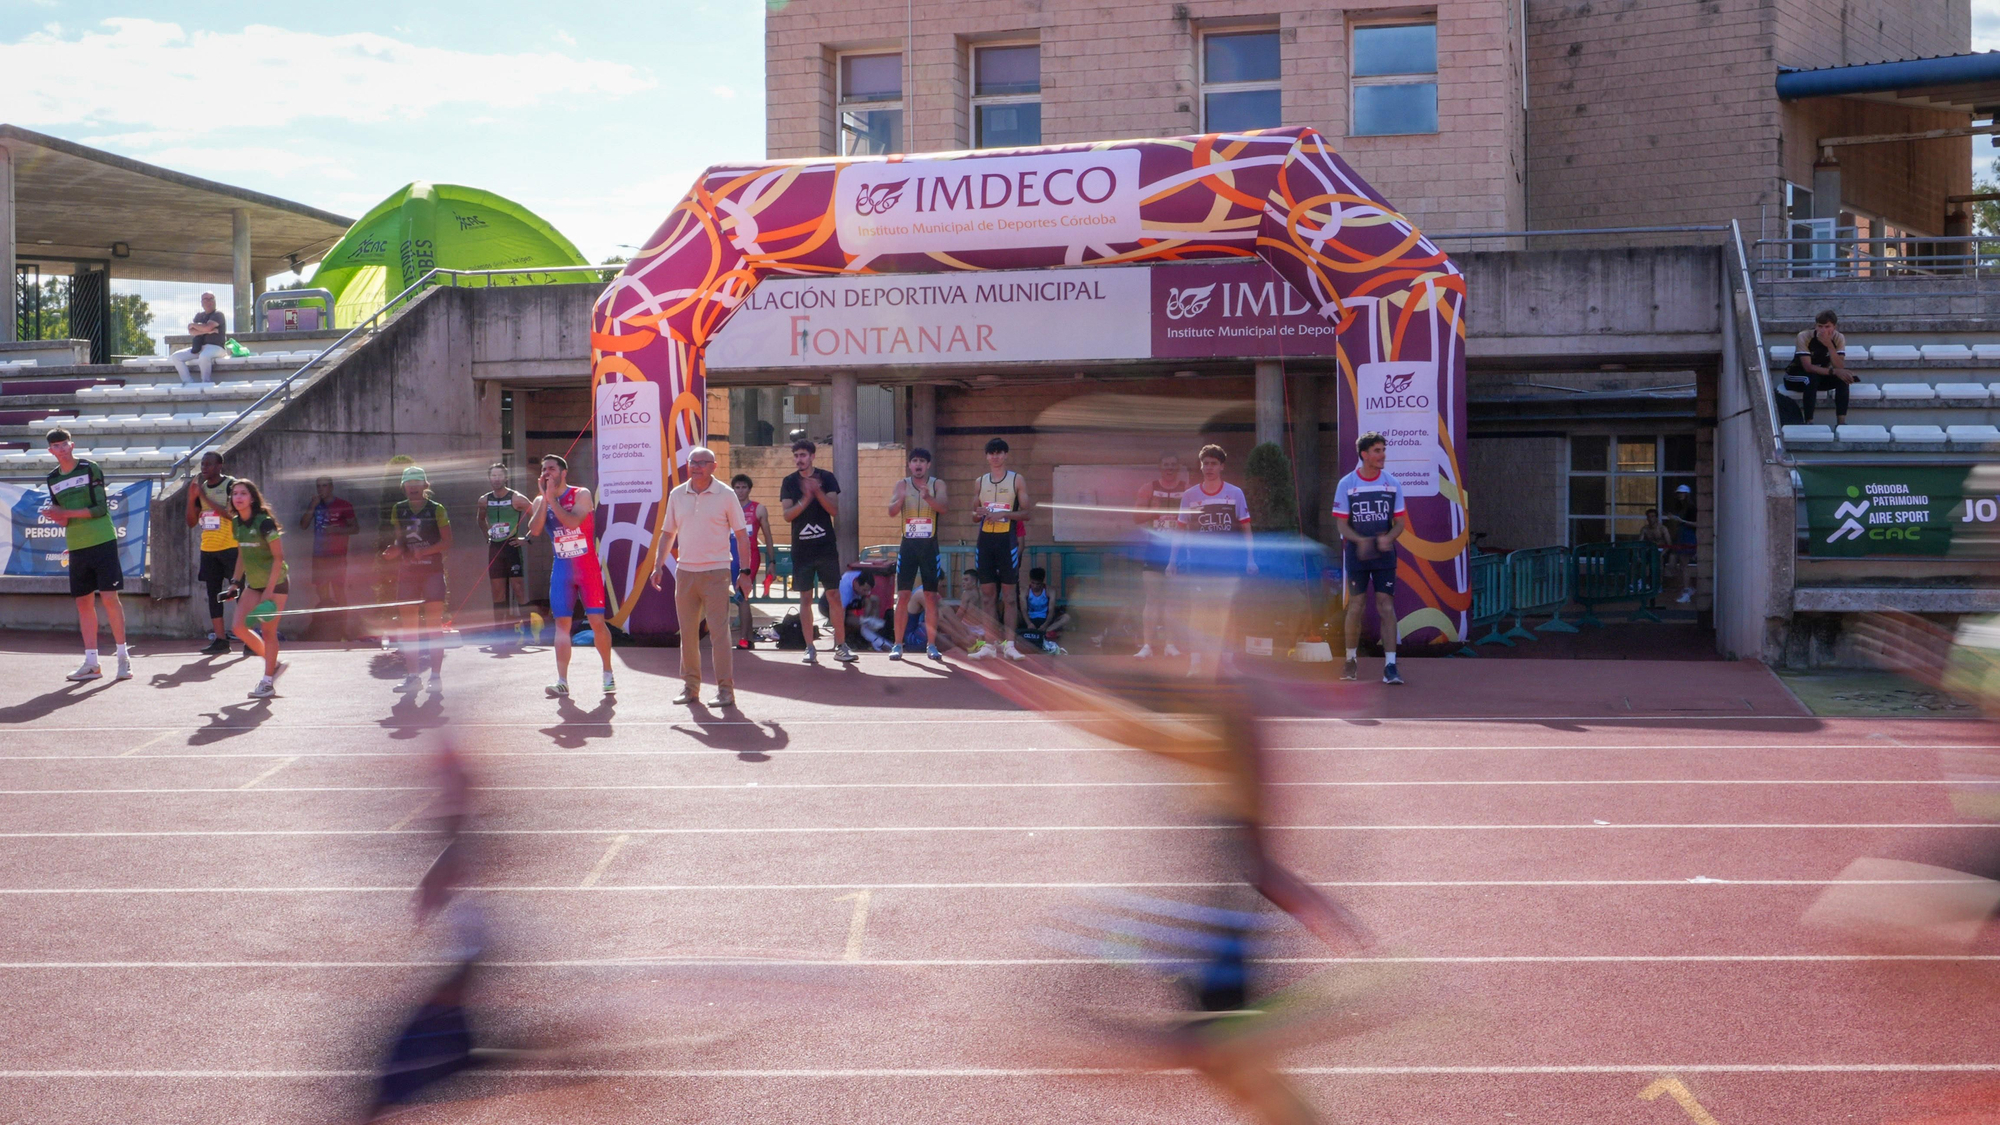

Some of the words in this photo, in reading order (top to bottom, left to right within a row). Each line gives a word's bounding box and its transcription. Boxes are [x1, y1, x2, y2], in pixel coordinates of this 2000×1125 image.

[915, 166, 1117, 213] IMDECO
[858, 223, 909, 237] Instituto
[912, 220, 975, 235] Municipal
[978, 220, 994, 231] de
[998, 217, 1057, 232] Deportes
[1060, 214, 1117, 227] Córdoba
[844, 285, 967, 307] DEPORTIVA
[974, 281, 1106, 304] MUNICIPAL
[1168, 327, 1215, 338] Instituto
[1218, 325, 1276, 338] Municipal
[1279, 325, 1295, 336] de
[1366, 395, 1429, 410] IMDECO
[601, 412, 651, 426] IMDECO
[1392, 429, 1429, 438] Deporte.
[619, 442, 651, 450] Deporte.
[612, 451, 645, 459] Córdoba.
[1865, 483, 1909, 494] CÓRDOBA
[1872, 495, 1929, 506] PATRIMONIO
[1352, 500, 1390, 515] CELTA
[1869, 511, 1893, 524] AIRE
[1895, 510, 1929, 523] SPORT
[1868, 527, 1920, 540] CAC
